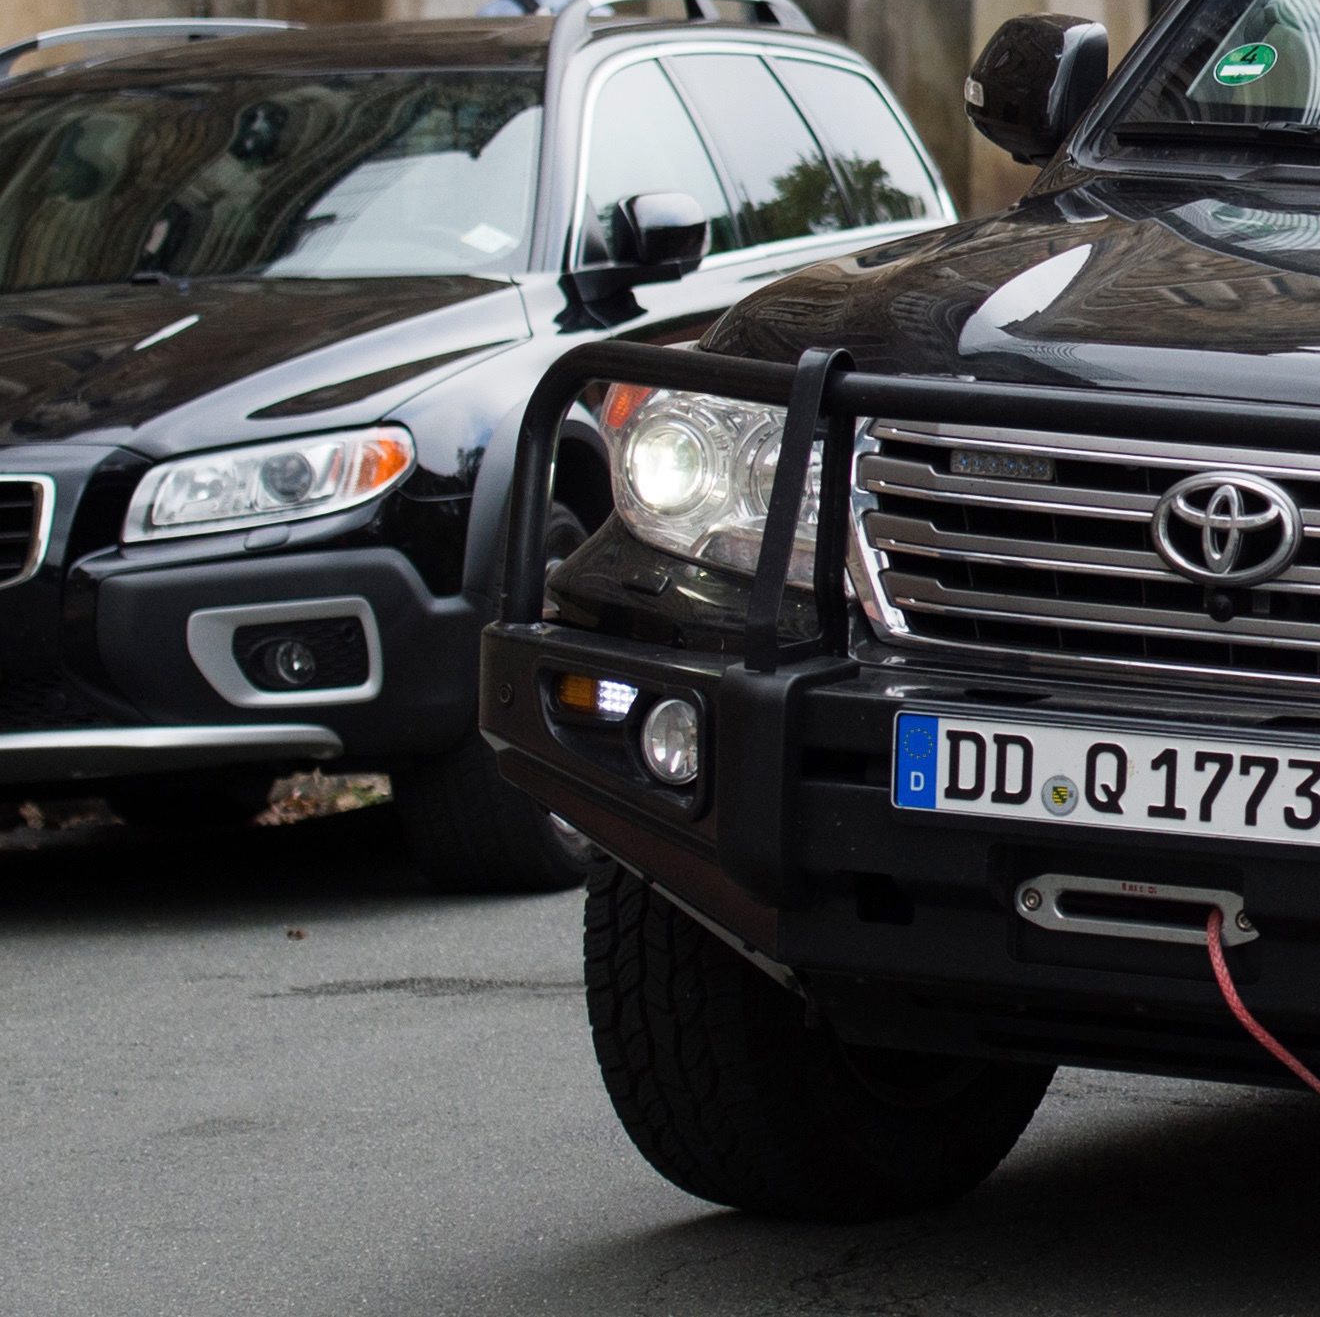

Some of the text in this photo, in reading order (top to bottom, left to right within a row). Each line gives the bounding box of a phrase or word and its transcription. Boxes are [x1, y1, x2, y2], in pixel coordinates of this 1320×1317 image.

[1240, 45, 1260, 64] 4
[910, 771, 924, 791] D
[944, 729, 1034, 805] DD
[1084, 742, 1128, 815] Q
